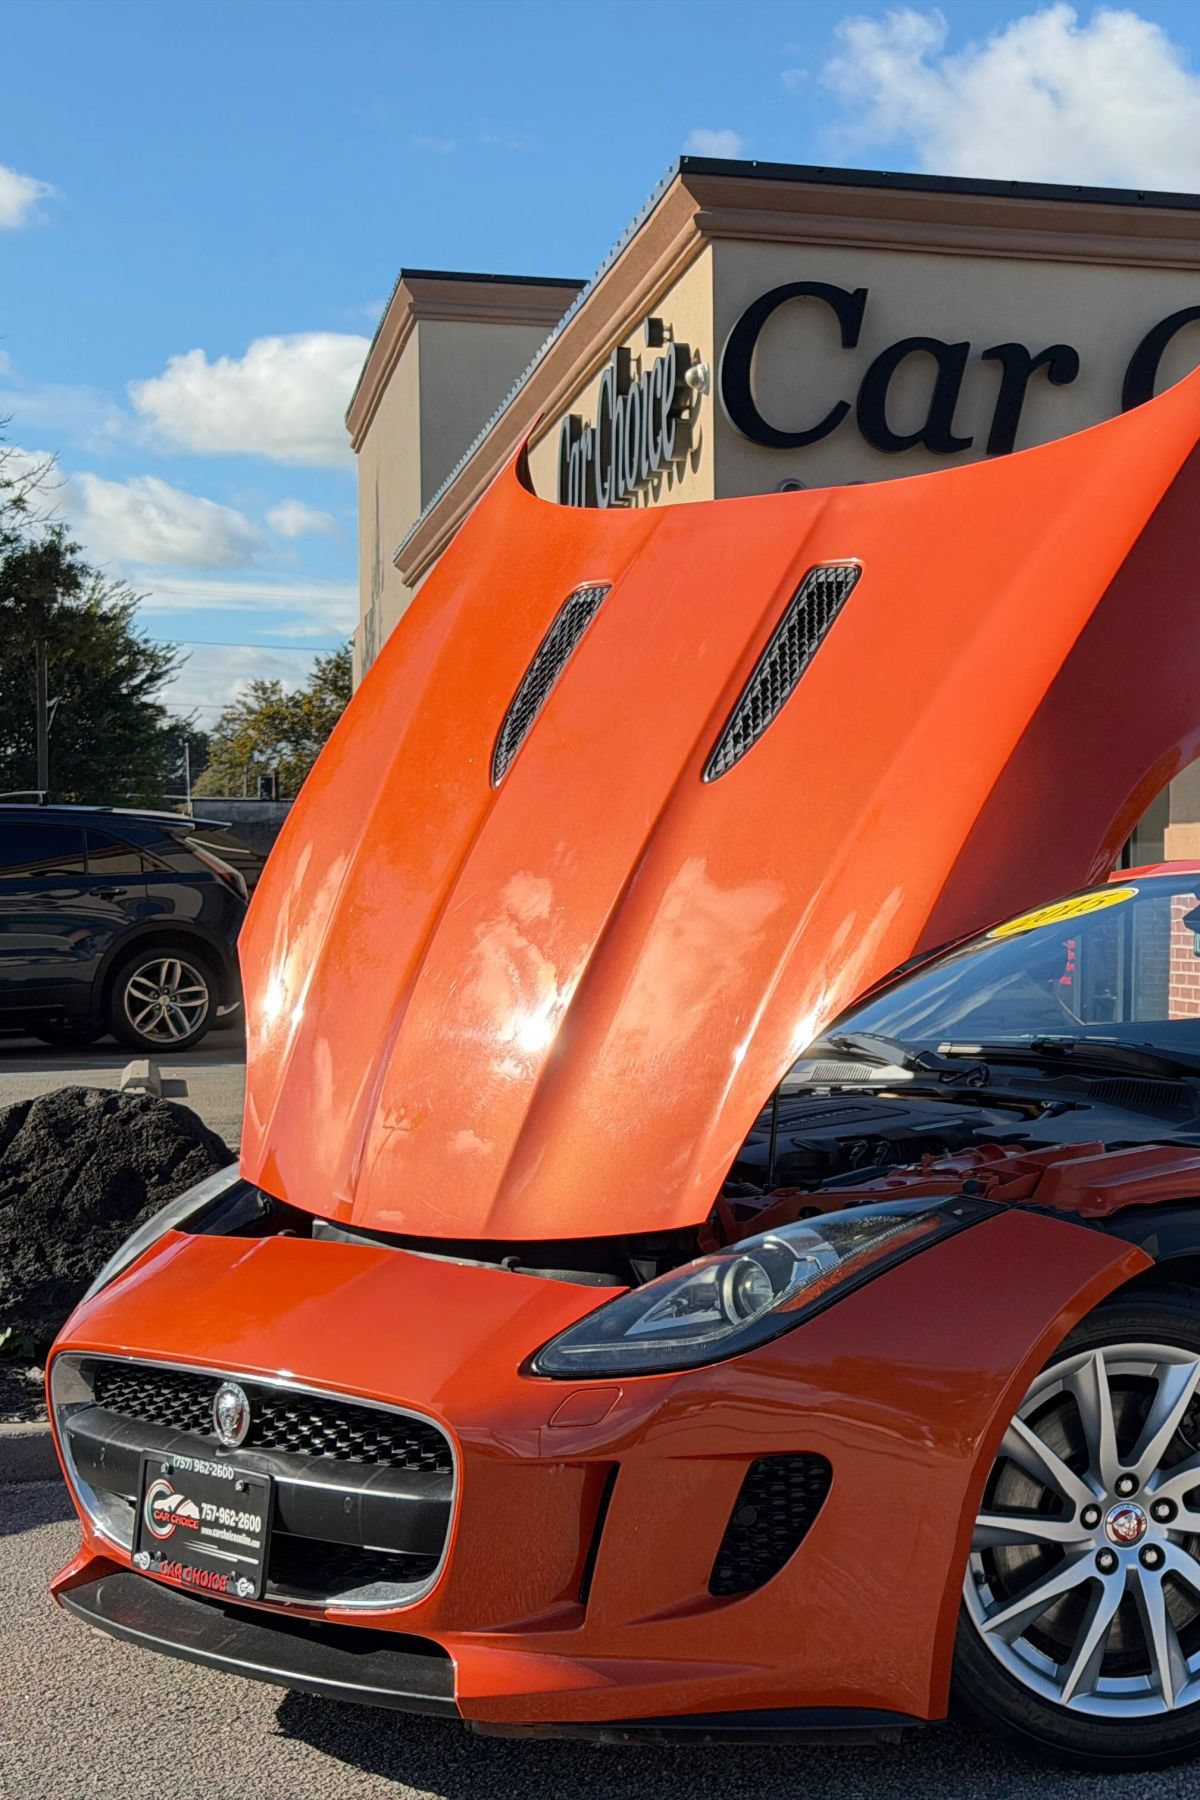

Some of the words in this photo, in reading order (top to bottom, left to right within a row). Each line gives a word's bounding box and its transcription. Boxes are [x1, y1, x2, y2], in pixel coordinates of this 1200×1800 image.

[721, 281, 1079, 456] Car
[596, 317, 688, 508] Choice
[173, 1455, 193, 1471] (757)
[193, 1458, 235, 1480] 962-2600
[153, 1510, 170, 1522] CAR
[170, 1513, 200, 1529] CHOICE
[201, 1502, 262, 1533] 757-962-2600
[160, 1560, 183, 1579] CAR
[184, 1566, 228, 1592] CHOICE
